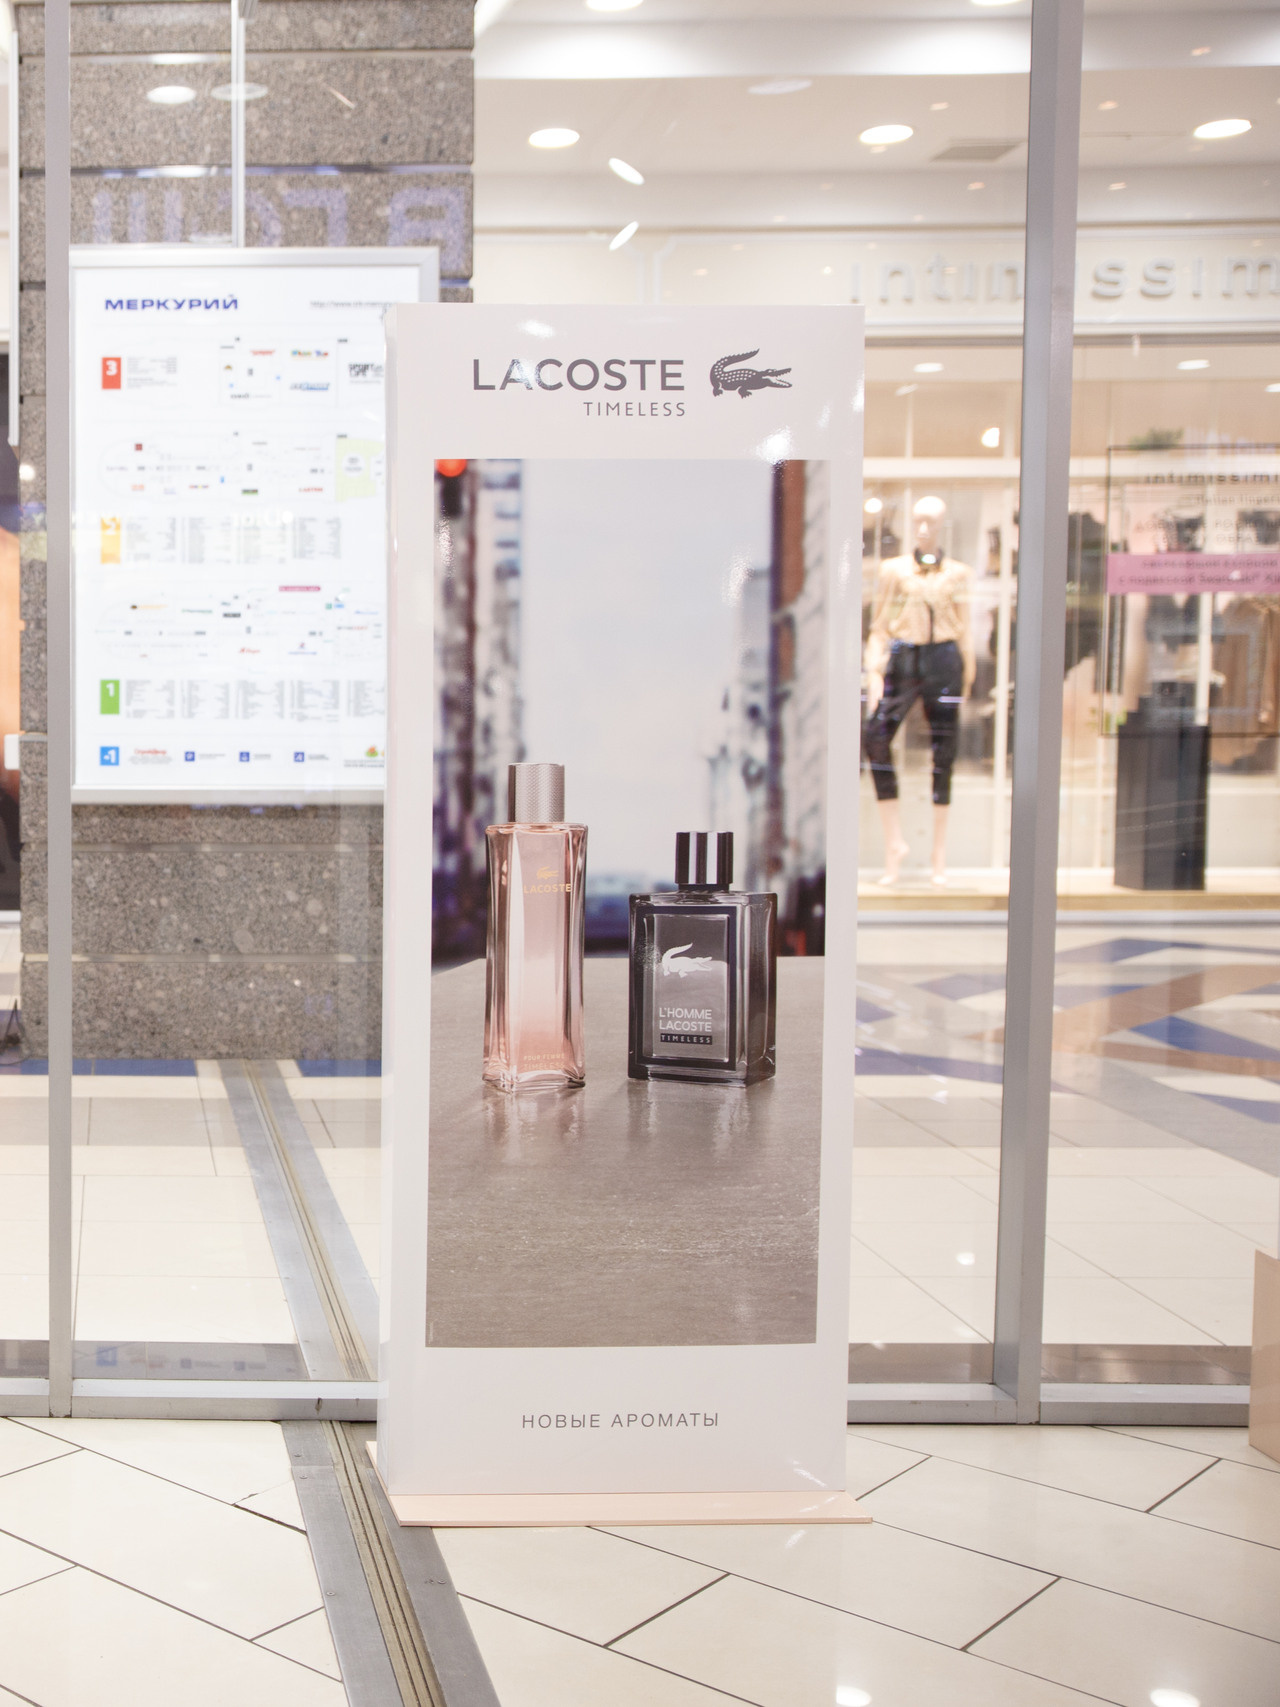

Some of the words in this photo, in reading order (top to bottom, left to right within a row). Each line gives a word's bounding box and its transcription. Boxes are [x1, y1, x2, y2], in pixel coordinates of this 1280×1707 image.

[105, 294, 238, 311] МЕРКУРИЙ
[106, 360, 118, 376] 3
[473, 358, 684, 391] LACOSTE
[583, 402, 686, 417] TIMELESS
[106, 682, 115, 698] 1
[523, 883, 572, 894] LACOSTE
[659, 1007, 712, 1020] L'HOMME
[659, 1020, 712, 1032] LACOSTE
[661, 1034, 711, 1043] TIMELESS
[522, 1414, 601, 1428] НОВЫЕ
[611, 1412, 719, 1428] АРОМАТЫ
